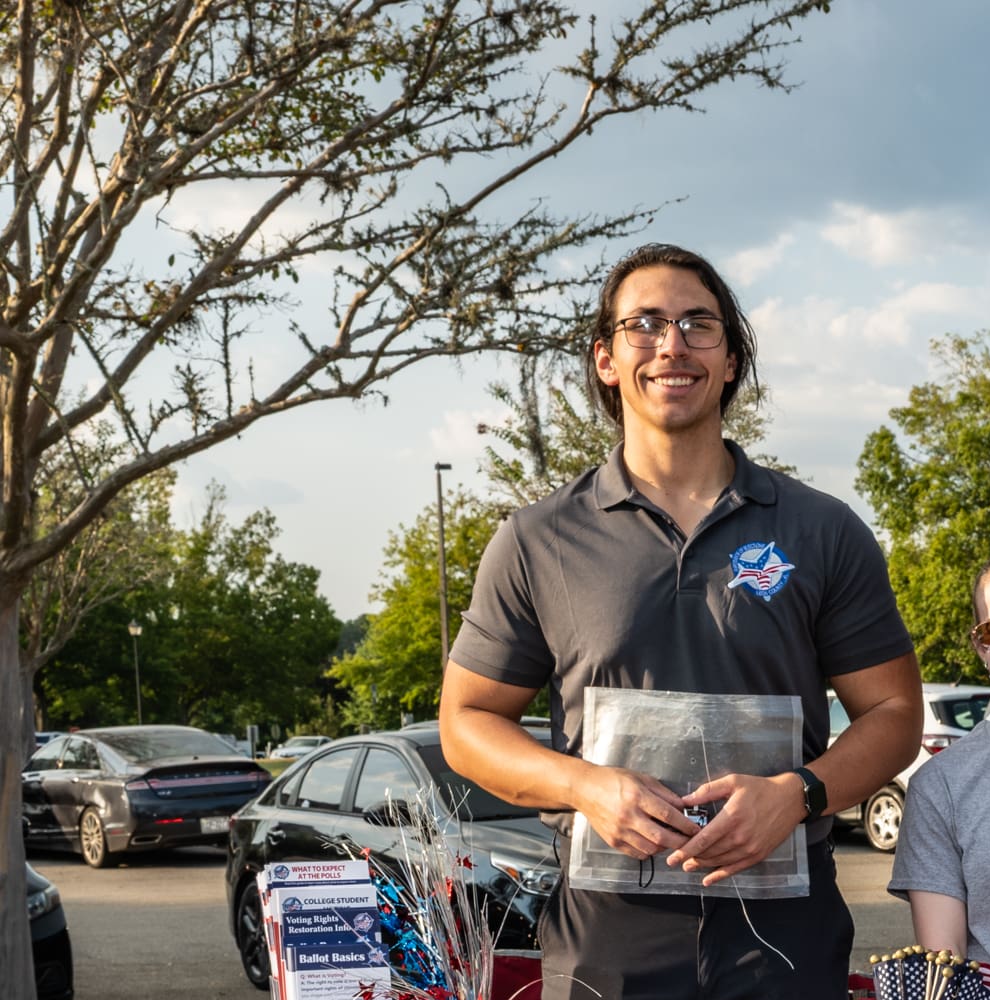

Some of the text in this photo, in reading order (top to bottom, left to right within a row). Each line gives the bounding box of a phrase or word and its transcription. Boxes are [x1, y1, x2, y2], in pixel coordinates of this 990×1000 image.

[303, 896, 369, 905] COLLEGE STUDENT
[286, 914, 339, 925] Voting Rights
[288, 924, 334, 934] Restoration
[299, 952, 366, 964] Ballot Basics
